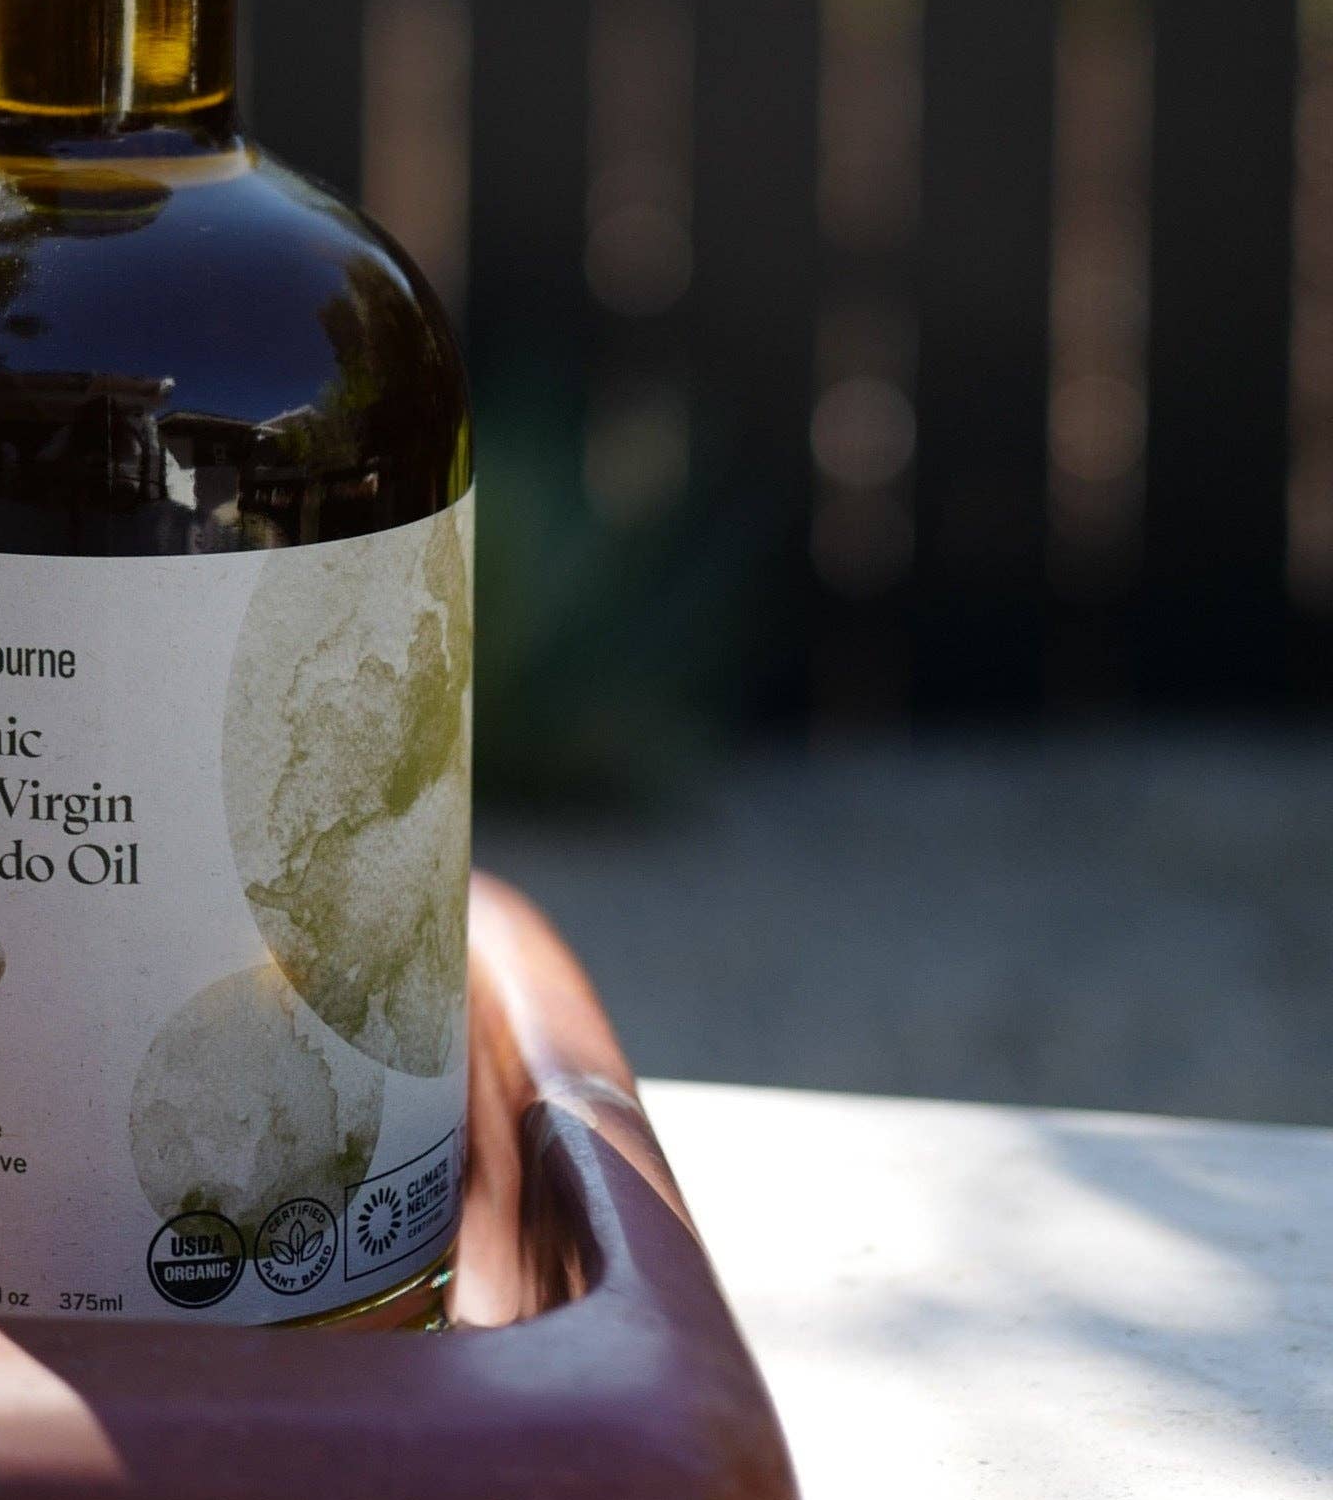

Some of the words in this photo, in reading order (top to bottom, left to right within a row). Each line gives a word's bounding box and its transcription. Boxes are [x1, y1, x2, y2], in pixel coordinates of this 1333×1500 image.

[68, 842, 142, 885] Oil
[407, 1157, 449, 1198] CLIMATE
[268, 1204, 326, 1233] CERTIFIED
[170, 1232, 225, 1258] USDA
[163, 1260, 232, 1283] ORGANIC
[262, 1261, 297, 1288] PLANT
[301, 1245, 333, 1286] BASED
[8, 1291, 31, 1307] oz
[59, 1292, 123, 1311] 375ml
